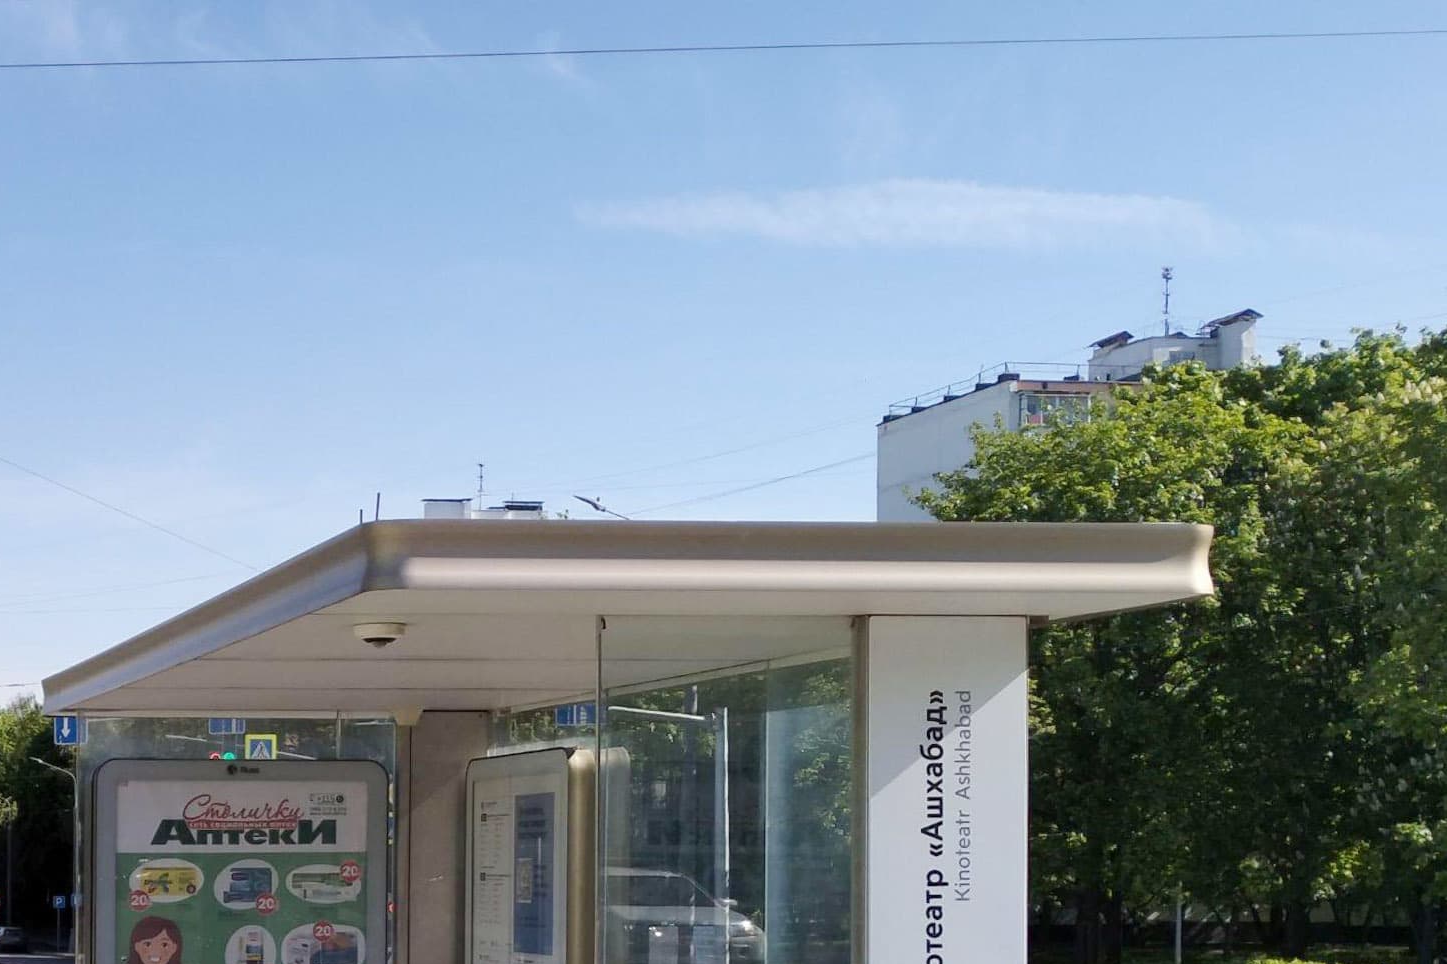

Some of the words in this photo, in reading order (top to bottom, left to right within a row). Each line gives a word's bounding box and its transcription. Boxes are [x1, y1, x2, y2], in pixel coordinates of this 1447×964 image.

[919, 689, 948, 858] «Ашхабад»
[954, 689, 972, 800] Ashkhabad
[182, 794, 304, 820] Столички
[954, 808, 972, 902] Kinoteatr
